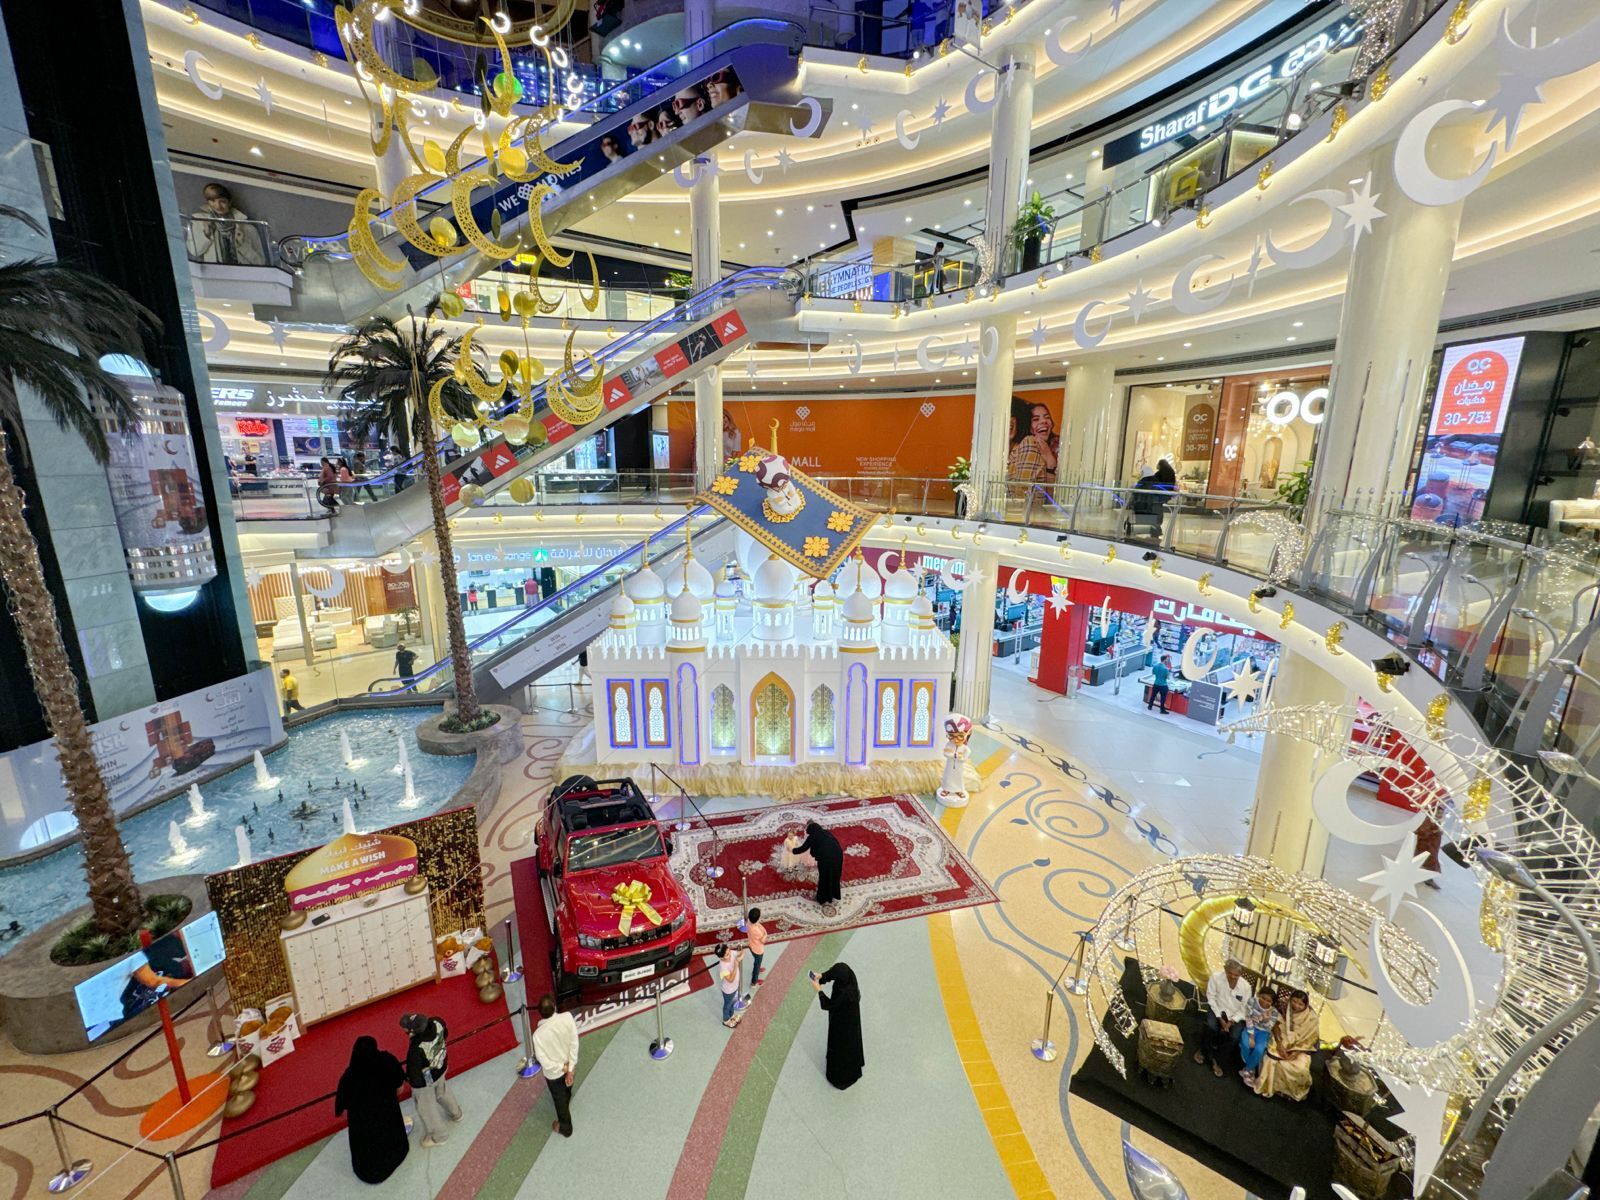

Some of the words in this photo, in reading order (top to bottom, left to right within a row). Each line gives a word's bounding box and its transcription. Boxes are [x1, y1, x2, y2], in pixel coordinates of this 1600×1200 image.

[1140, 100, 1208, 149] Sharaf
[1207, 64, 1273, 118] DG
[498, 194, 521, 212] WE
[1467, 357, 1493, 373] OC
[791, 456, 822, 468] MALL
[320, 858, 351, 876] MAKE
[352, 857, 359, 867] A
[360, 850, 386, 864] WISH
